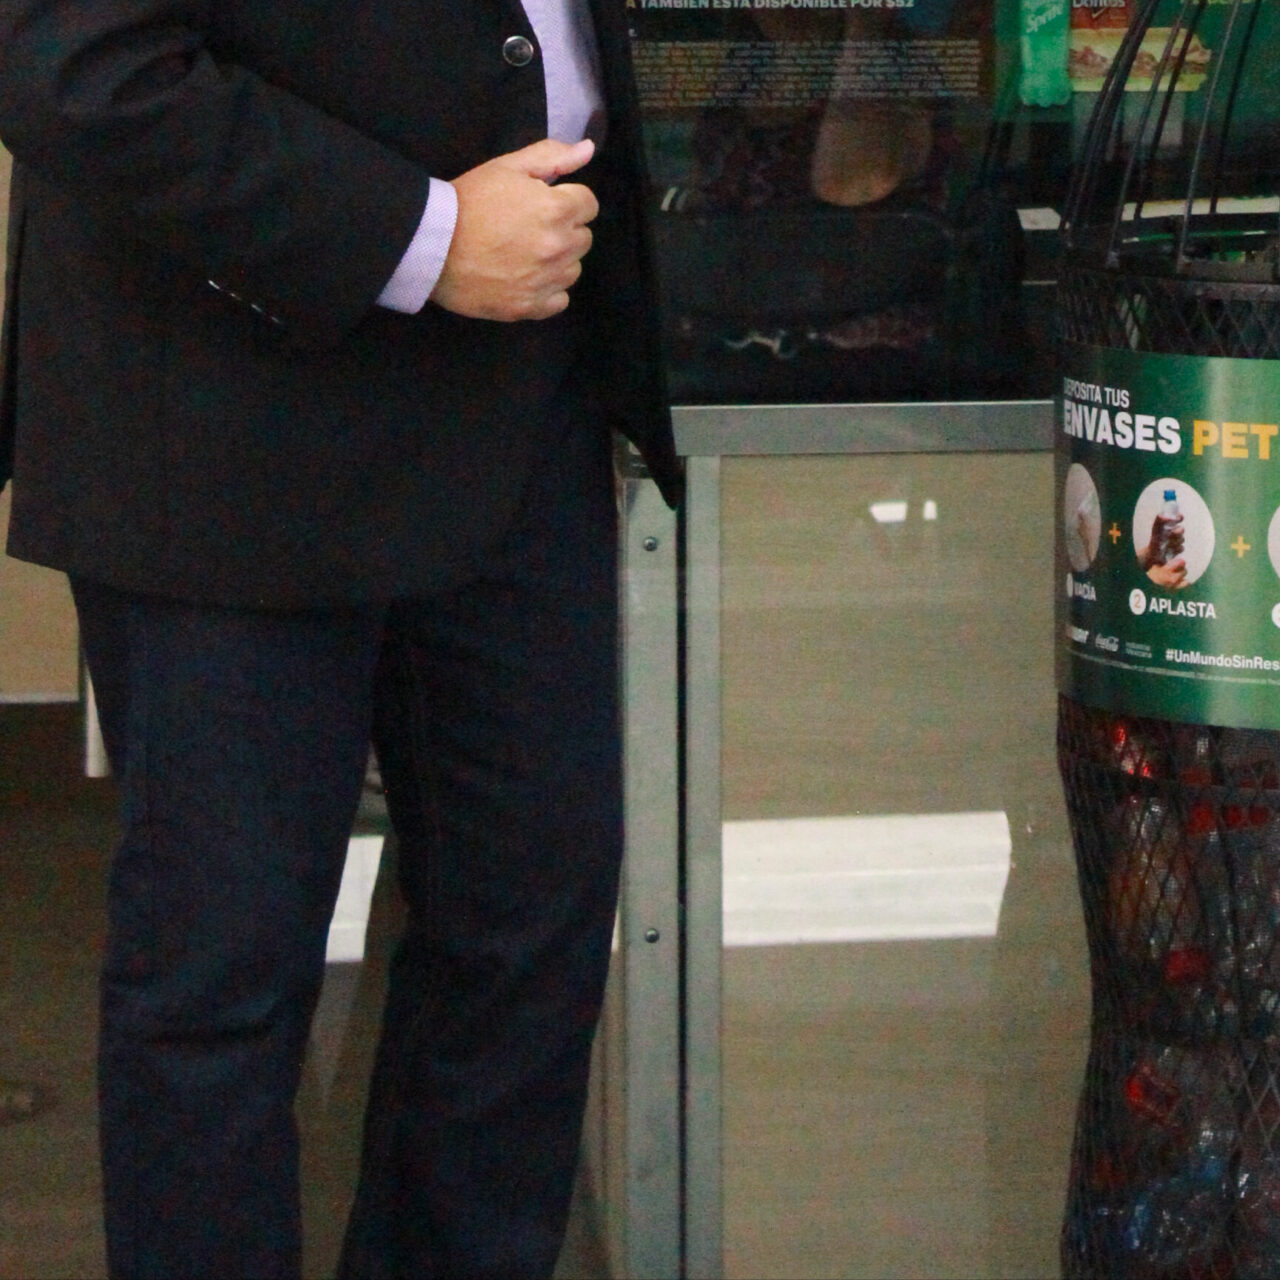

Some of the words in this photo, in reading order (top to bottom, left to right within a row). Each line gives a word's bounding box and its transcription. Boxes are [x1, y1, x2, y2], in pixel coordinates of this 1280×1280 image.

[1025, 2, 1063, 34] Sprite
[1104, 386, 1131, 408] TUS
[1064, 399, 1182, 454] ENVASES
[1193, 419, 1278, 460] PET
[1149, 597, 1217, 619] APLASTA
